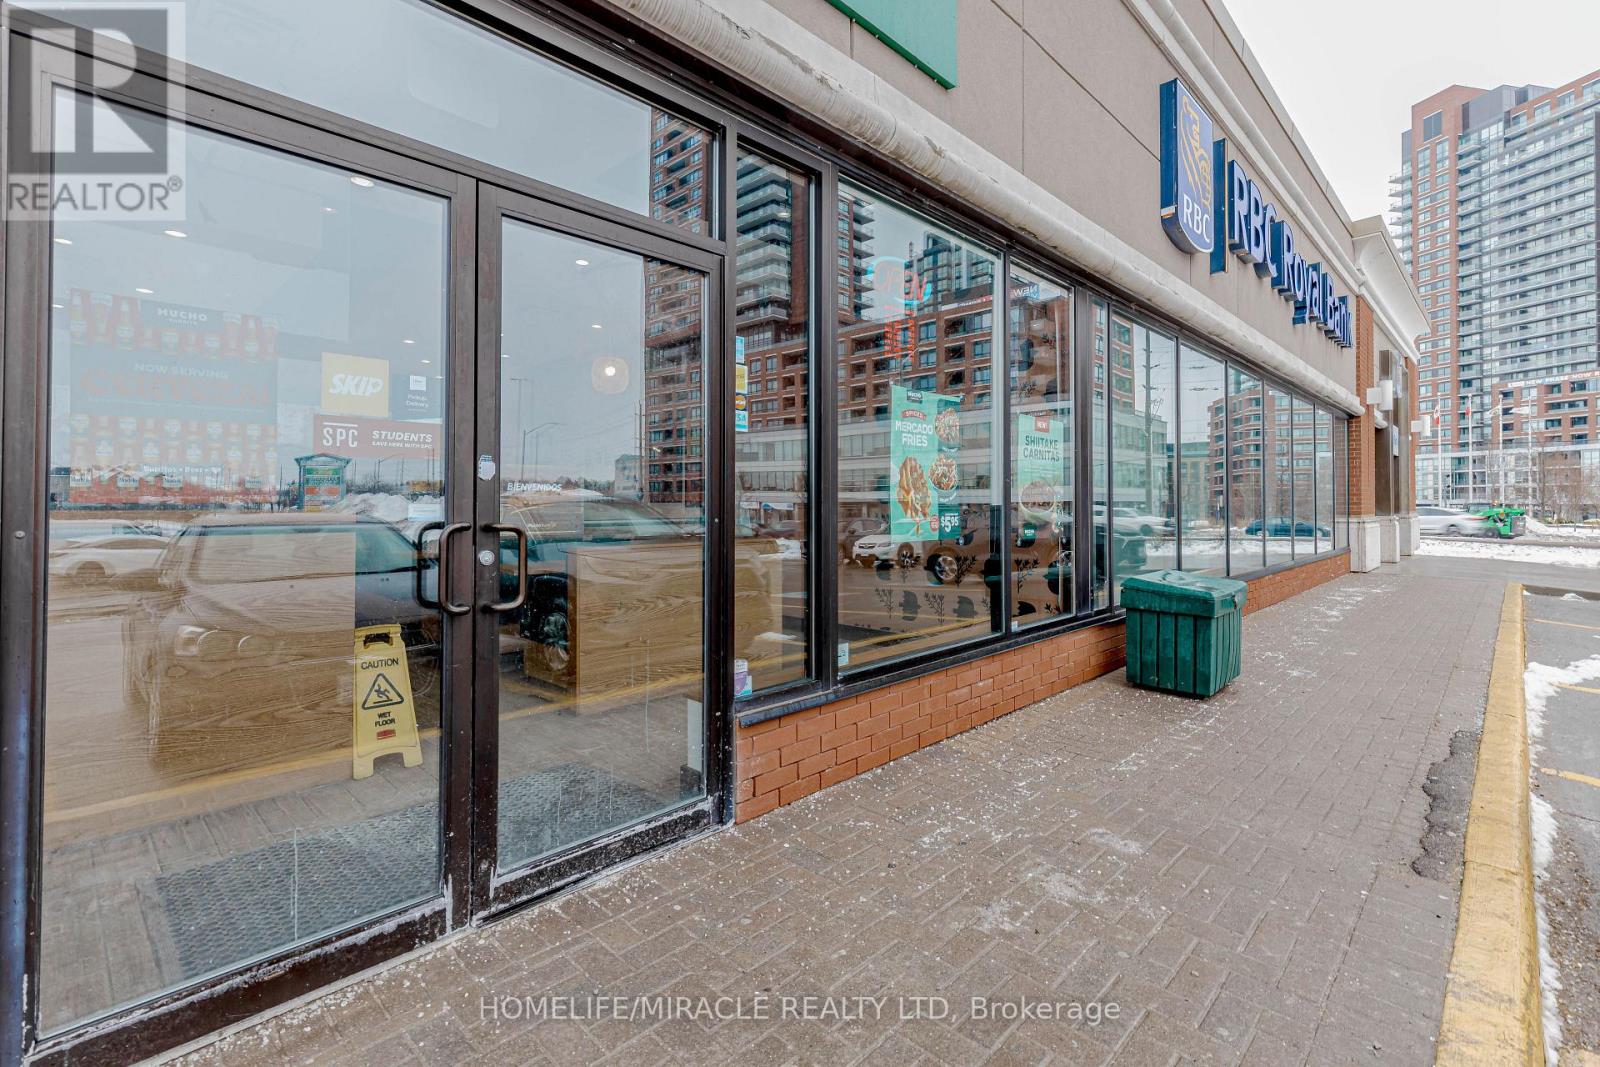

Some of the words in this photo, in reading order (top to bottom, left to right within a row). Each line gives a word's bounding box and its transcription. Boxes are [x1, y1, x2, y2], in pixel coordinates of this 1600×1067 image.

[1183, 193, 1211, 244] RBC
[1228, 160, 1278, 279] RBC
[1272, 220, 1323, 324] Royal
[1323, 272, 1353, 348] Bank
[873, 259, 927, 303] OPEN
[157, 307, 208, 322] MUCHO
[134, 363, 168, 375] NOW
[328, 373, 384, 397] SKIP
[895, 420, 934, 435] MERCADO
[322, 427, 358, 448] SPC
[372, 430, 433, 443] STUDENTS
[902, 433, 928, 447] FRIES
[1025, 435, 1059, 450] SHIITAKE
[1023, 448, 1060, 462] CARNITAS
[507, 482, 562, 492] BIENVENIDOS
[361, 657, 399, 670] CAUTION
[377, 711, 391, 719] WET
[375, 718, 395, 727] FLOOR
